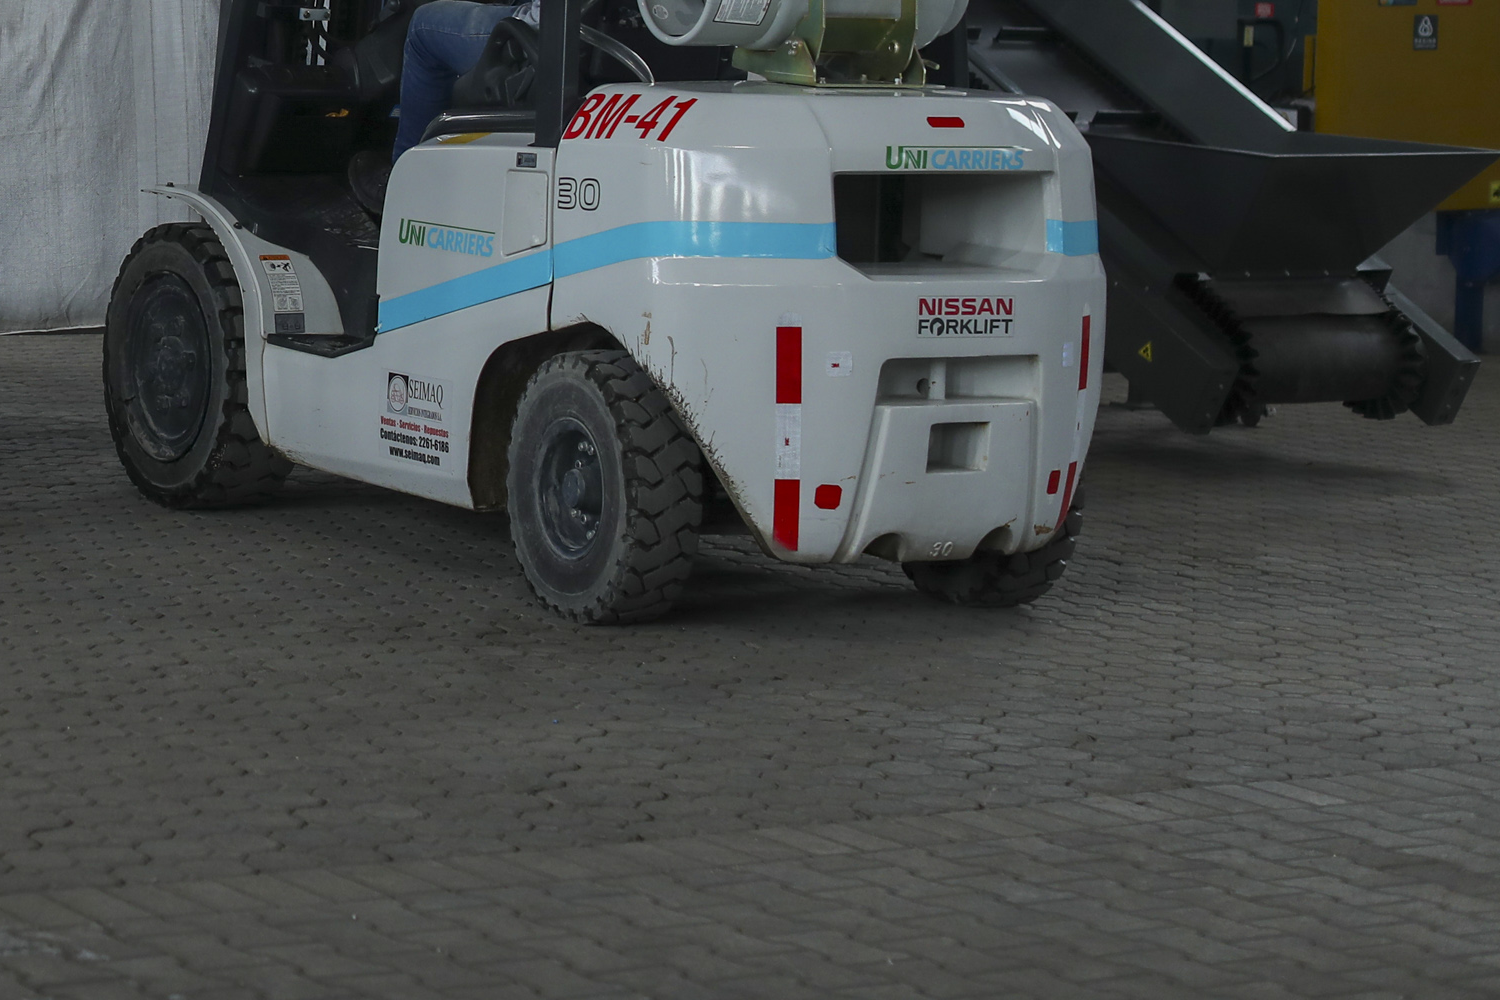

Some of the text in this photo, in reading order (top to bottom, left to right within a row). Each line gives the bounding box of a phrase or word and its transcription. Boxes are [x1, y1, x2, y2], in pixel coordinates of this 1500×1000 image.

[562, 93, 698, 141] BM-41
[558, 177, 600, 211] 30
[918, 298, 1013, 315] NISSAN
[918, 317, 1013, 336] FORKLIFT
[408, 378, 444, 409] SEIMAQ
